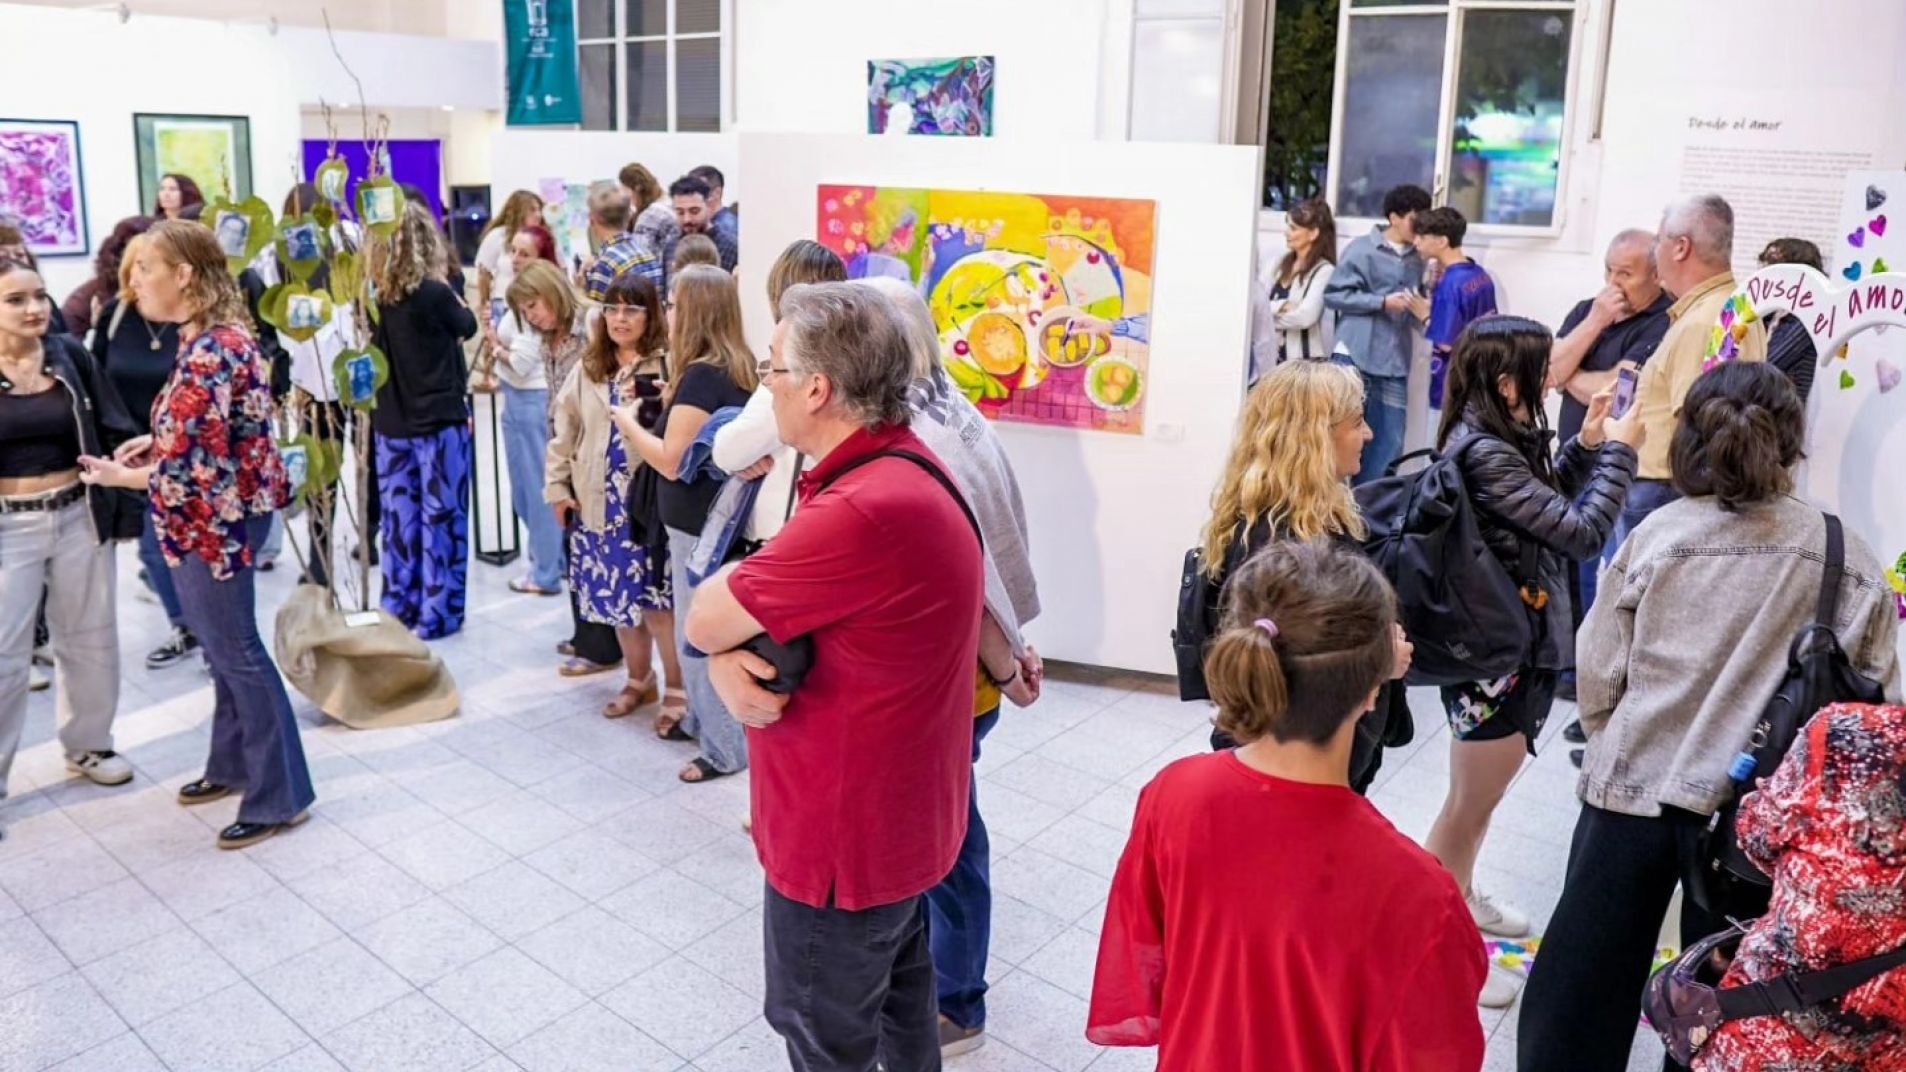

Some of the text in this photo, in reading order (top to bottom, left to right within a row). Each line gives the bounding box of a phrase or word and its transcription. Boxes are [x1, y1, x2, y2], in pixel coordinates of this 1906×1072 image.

[1689, 116, 1783, 131] Desde el amor
[1748, 272, 1906, 338] Desde el amo
